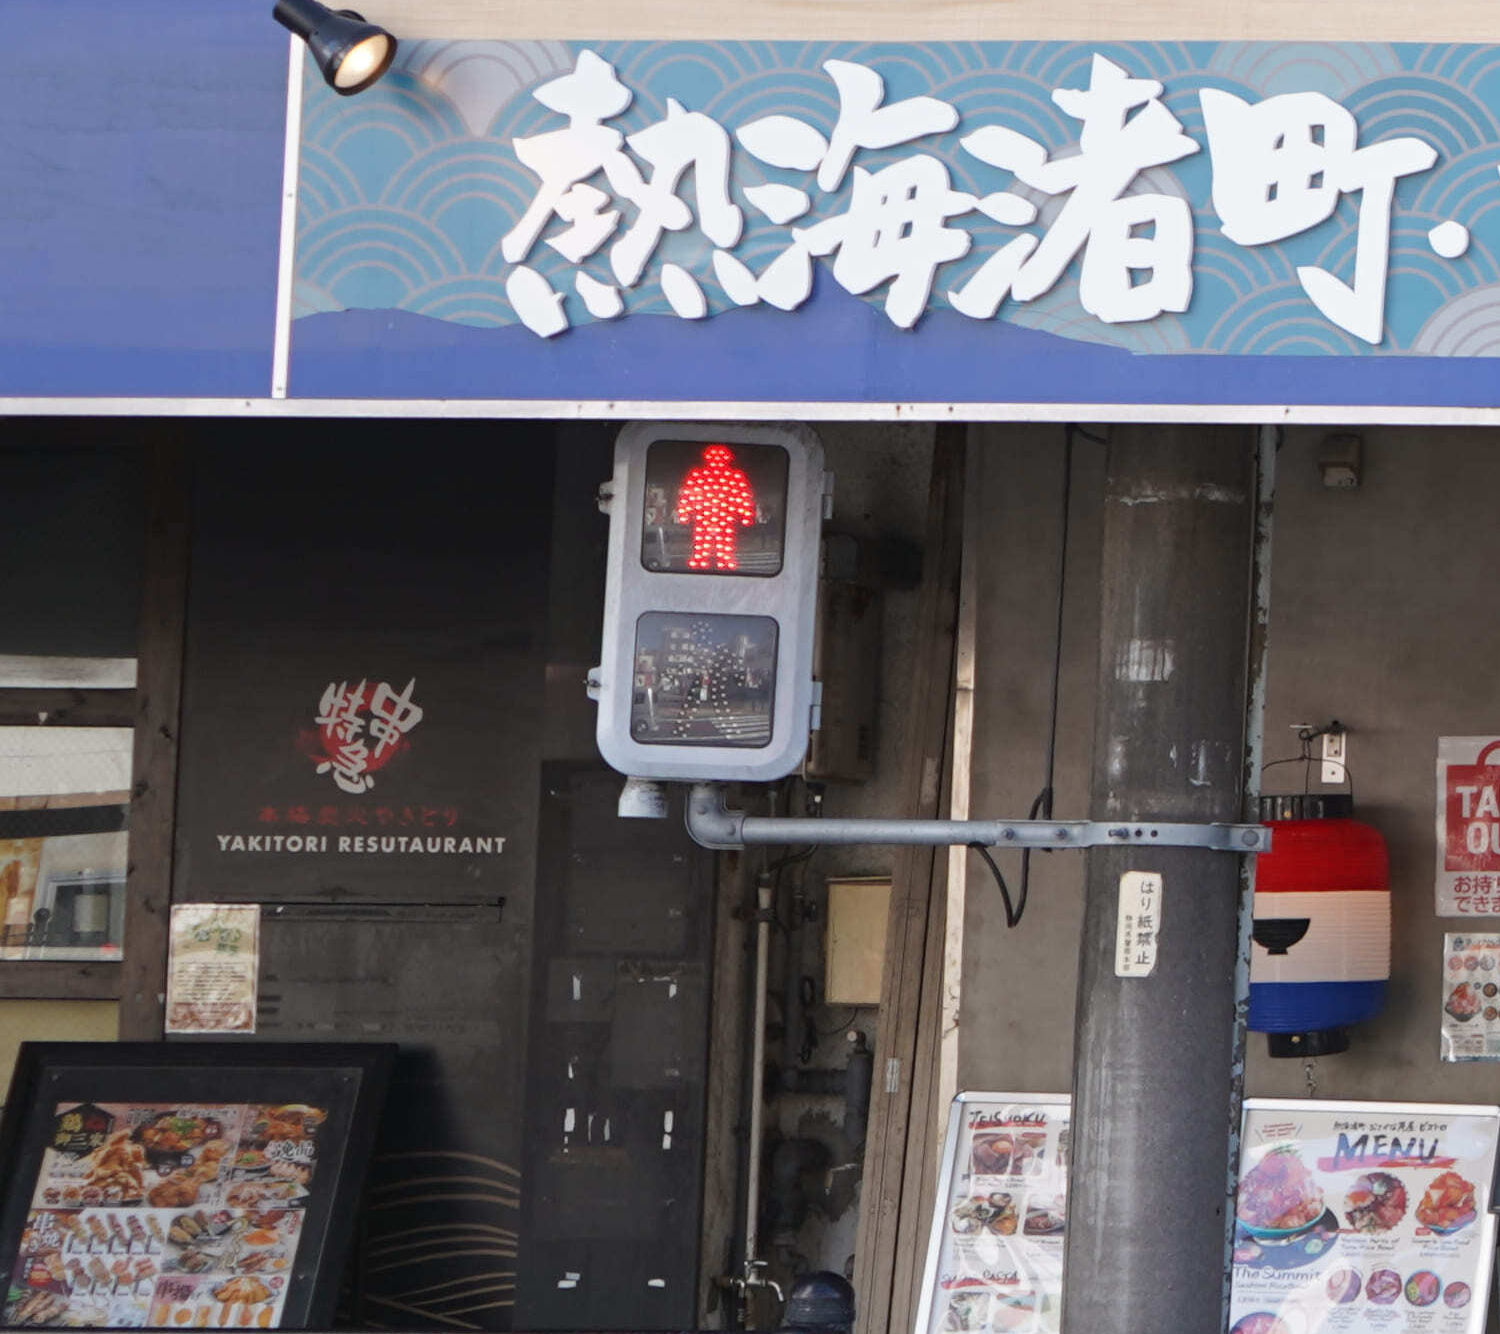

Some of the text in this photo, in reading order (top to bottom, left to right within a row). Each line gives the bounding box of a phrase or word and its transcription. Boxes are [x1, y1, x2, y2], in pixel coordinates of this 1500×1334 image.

[216, 834, 507, 855] YAKITORI RESUTAURANT
[1135, 880, 1155, 965] はり紙禁止
[1333, 1132, 1439, 1169] MENU
[1234, 1266, 1260, 1278] The
